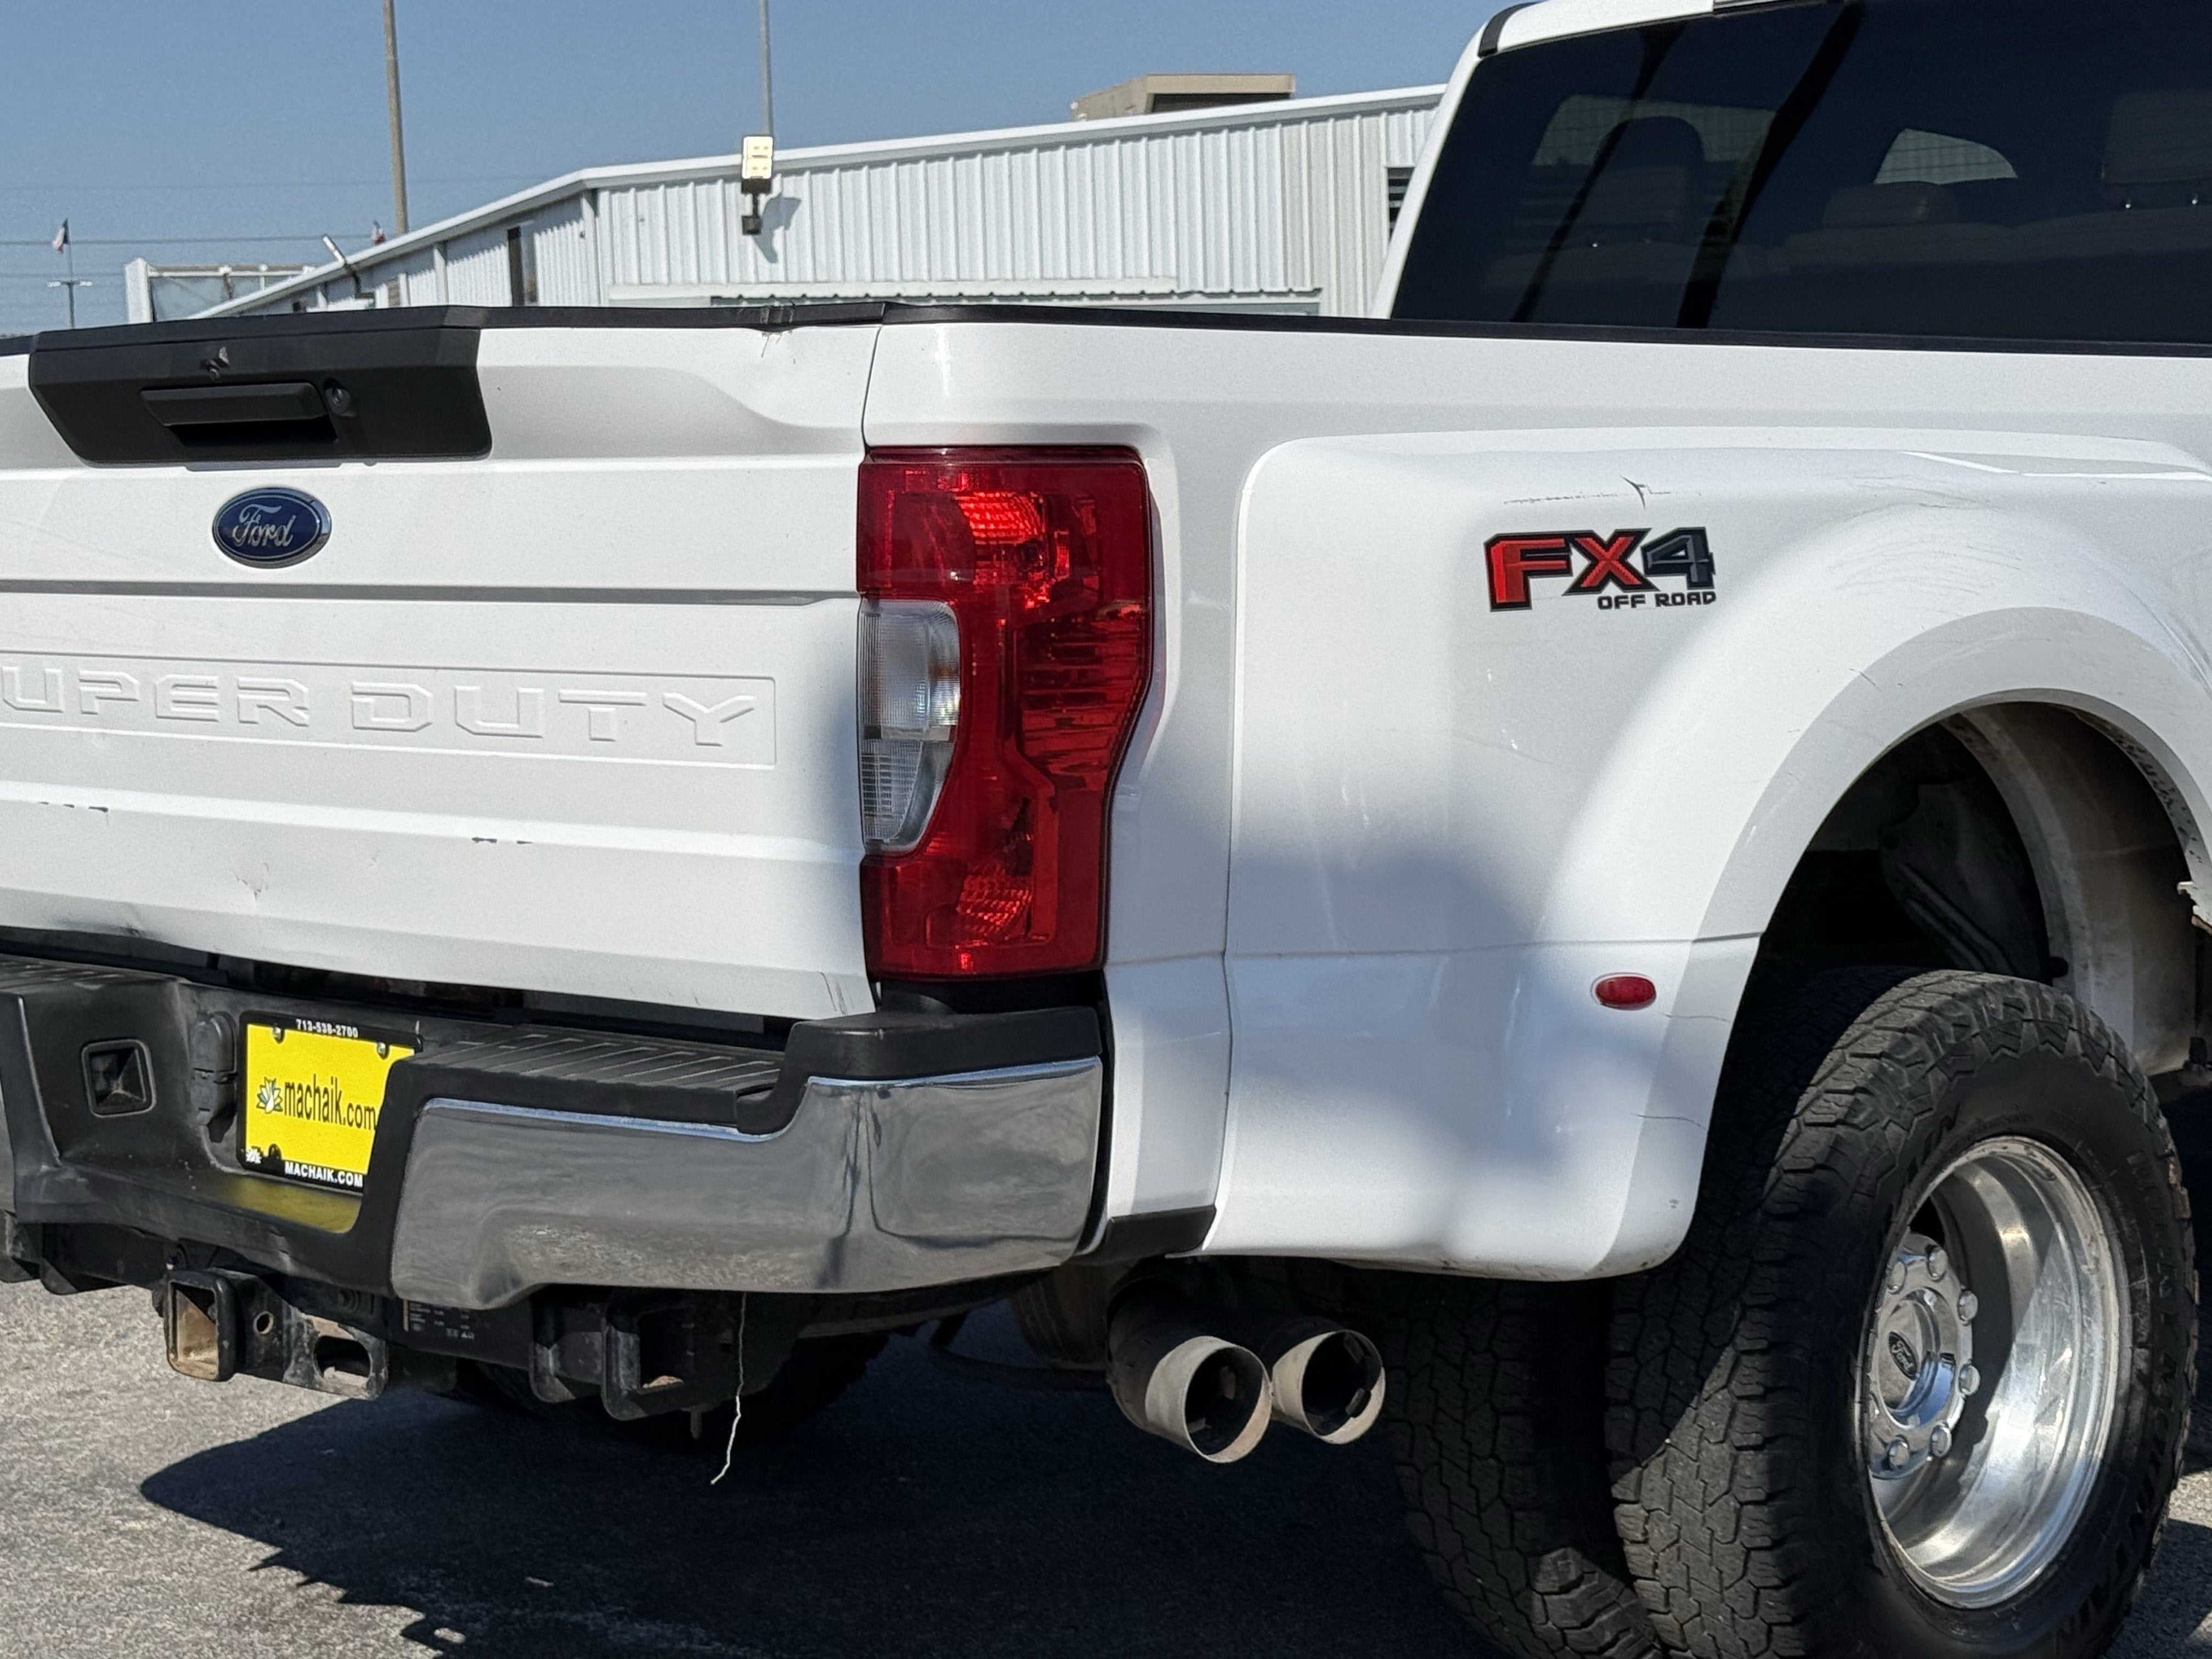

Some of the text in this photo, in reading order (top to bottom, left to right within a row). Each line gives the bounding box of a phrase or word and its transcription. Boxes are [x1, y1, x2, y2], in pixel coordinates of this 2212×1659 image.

[233, 503, 296, 547] Ford
[1483, 526, 1715, 612] FX4
[1597, 591, 1716, 610] OFF ROAD
[351, 681, 756, 747] DUTY
[296, 1018, 359, 1039] 713-538-2700
[284, 1073, 376, 1130] machaik.com
[285, 1161, 363, 1188] MACHAIK.COM
[1892, 1340, 1914, 1371] Ford
